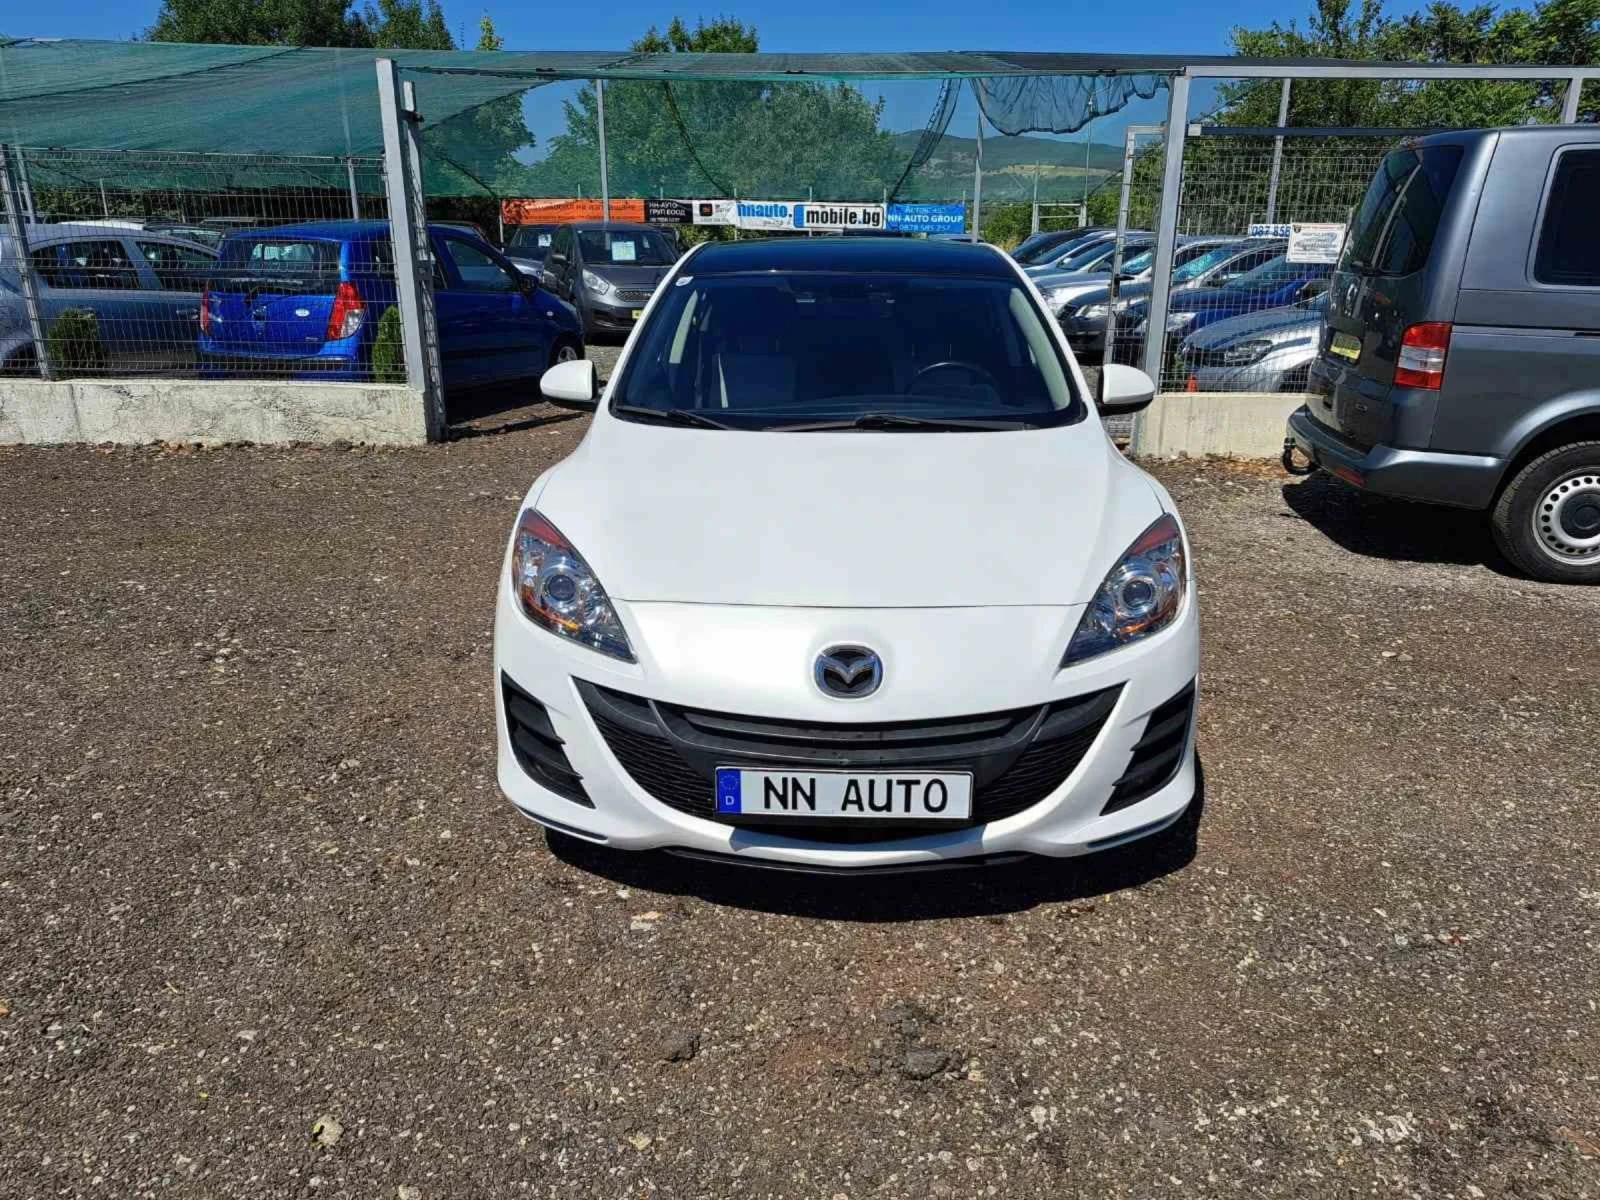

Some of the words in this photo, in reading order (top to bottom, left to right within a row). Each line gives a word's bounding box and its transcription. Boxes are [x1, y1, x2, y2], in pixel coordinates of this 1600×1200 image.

[806, 208, 881, 227] mobile.bg
[930, 215, 964, 223] GROUP
[725, 795, 735, 806] D
[763, 776, 816, 811] NN
[840, 778, 948, 813] AUTO
